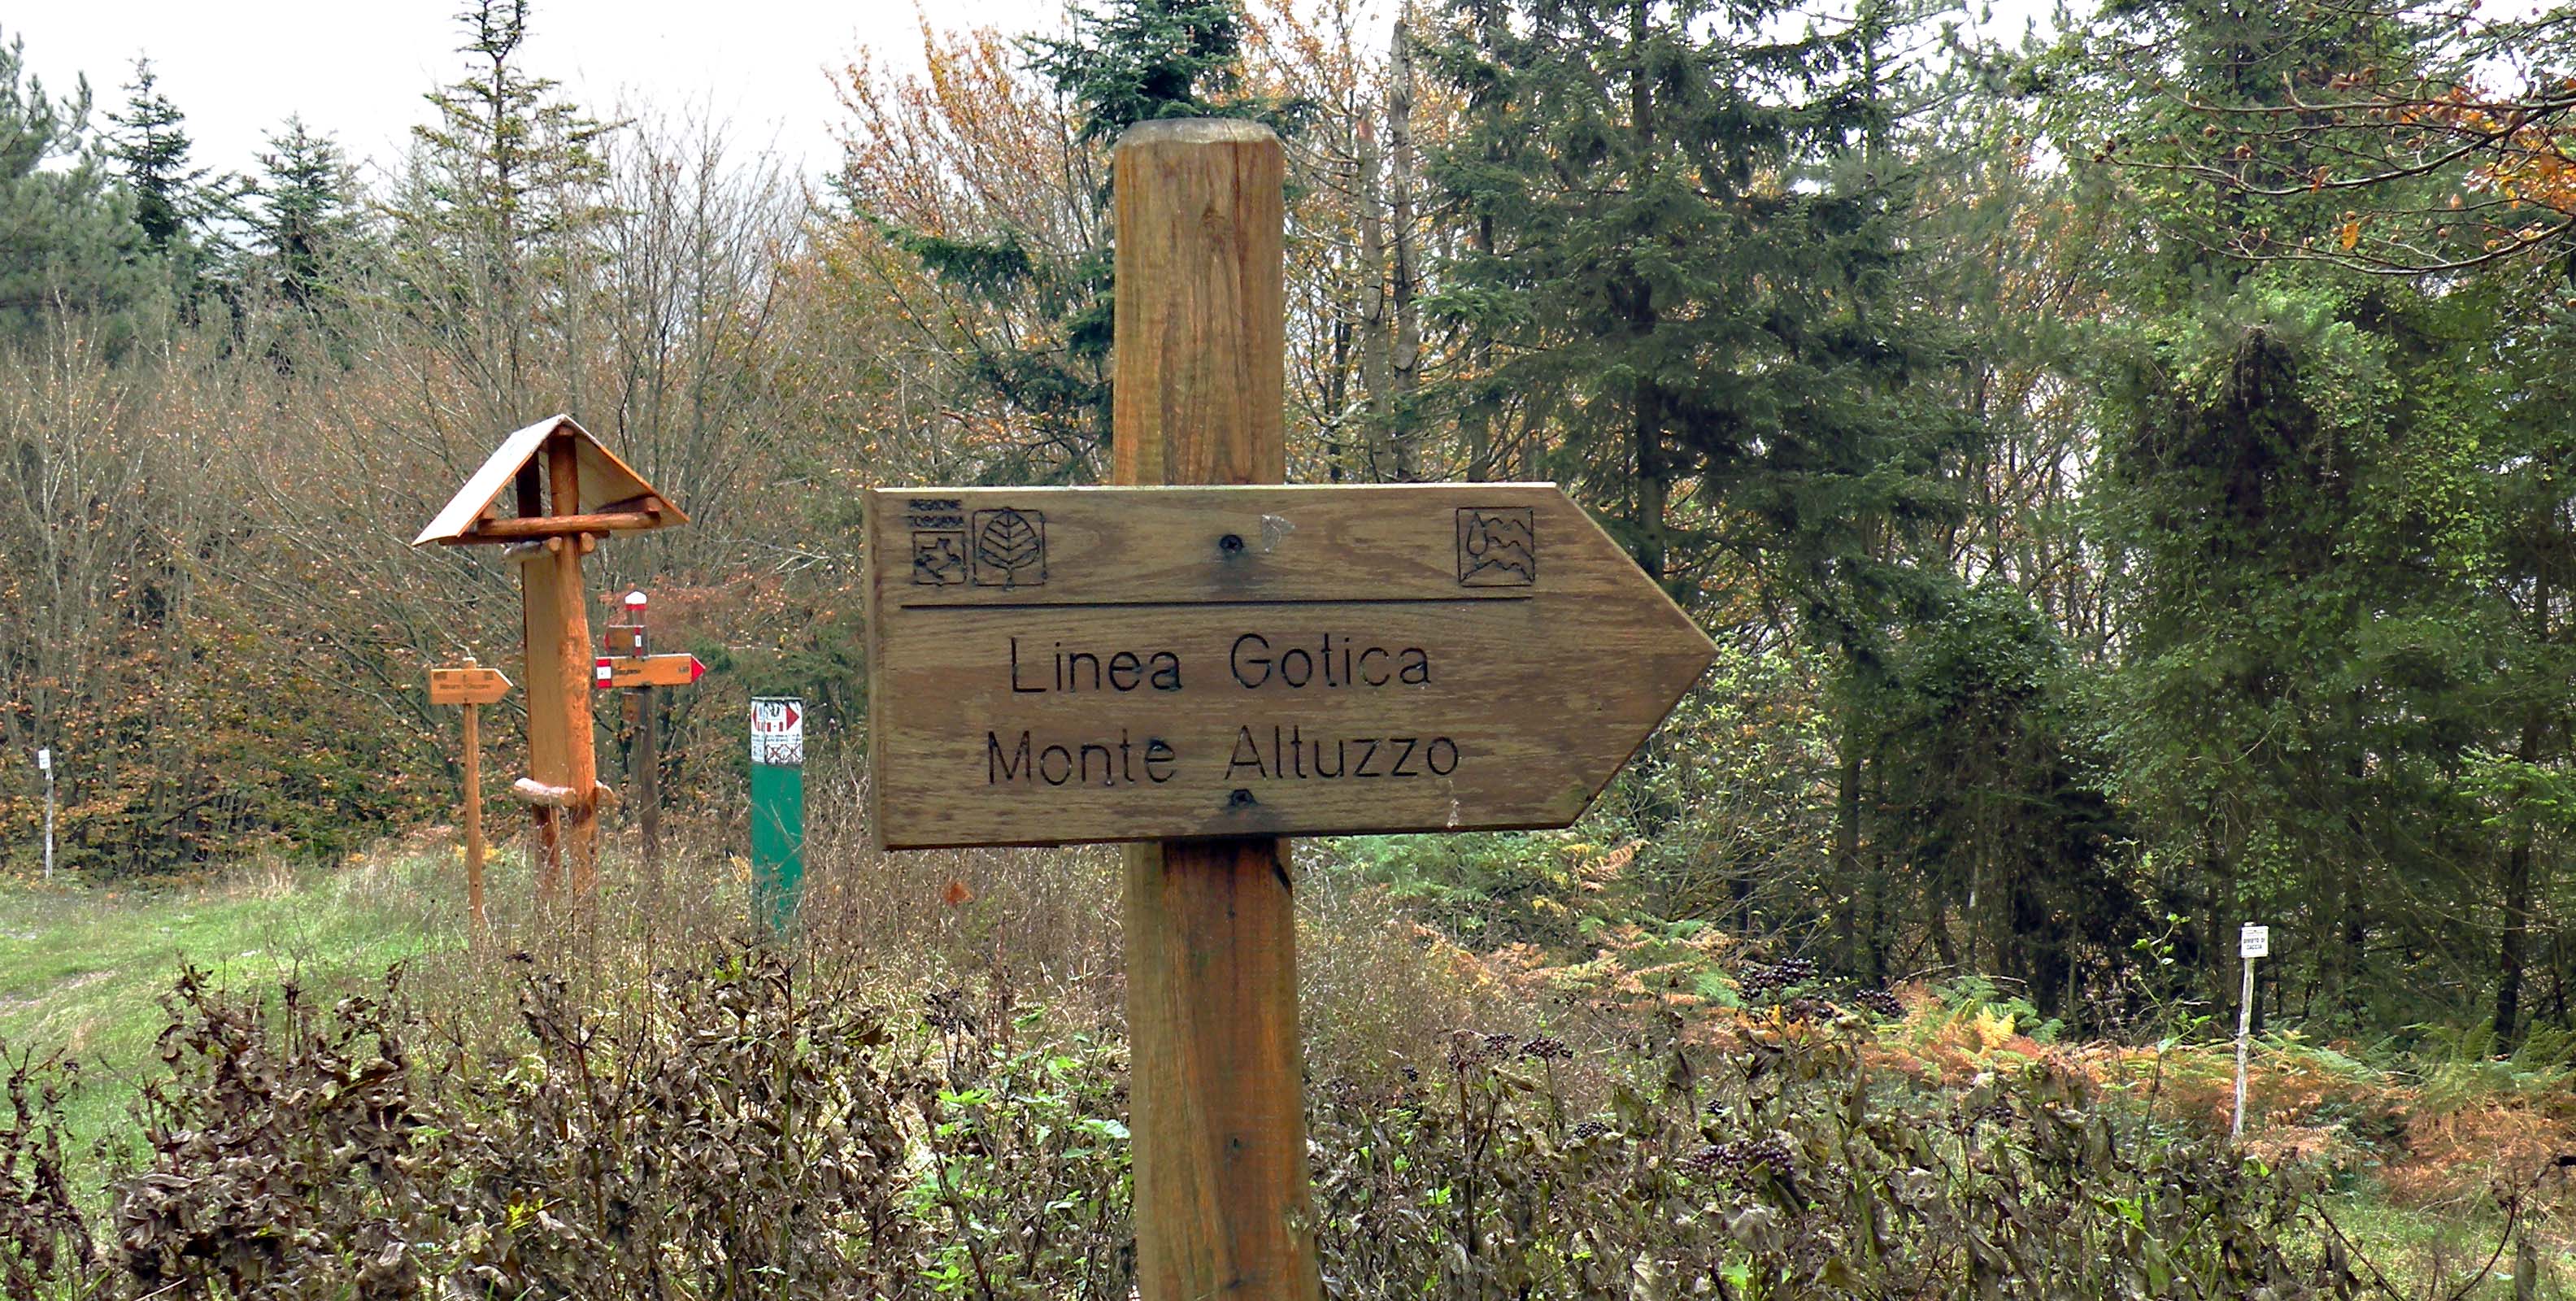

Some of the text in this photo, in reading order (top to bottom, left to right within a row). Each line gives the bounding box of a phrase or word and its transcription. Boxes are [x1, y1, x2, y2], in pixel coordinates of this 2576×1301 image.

[907, 516, 964, 528] TOSCANA
[1011, 633, 1431, 693] Linea Gotica
[987, 725, 1460, 785] Monte Altuzzo
